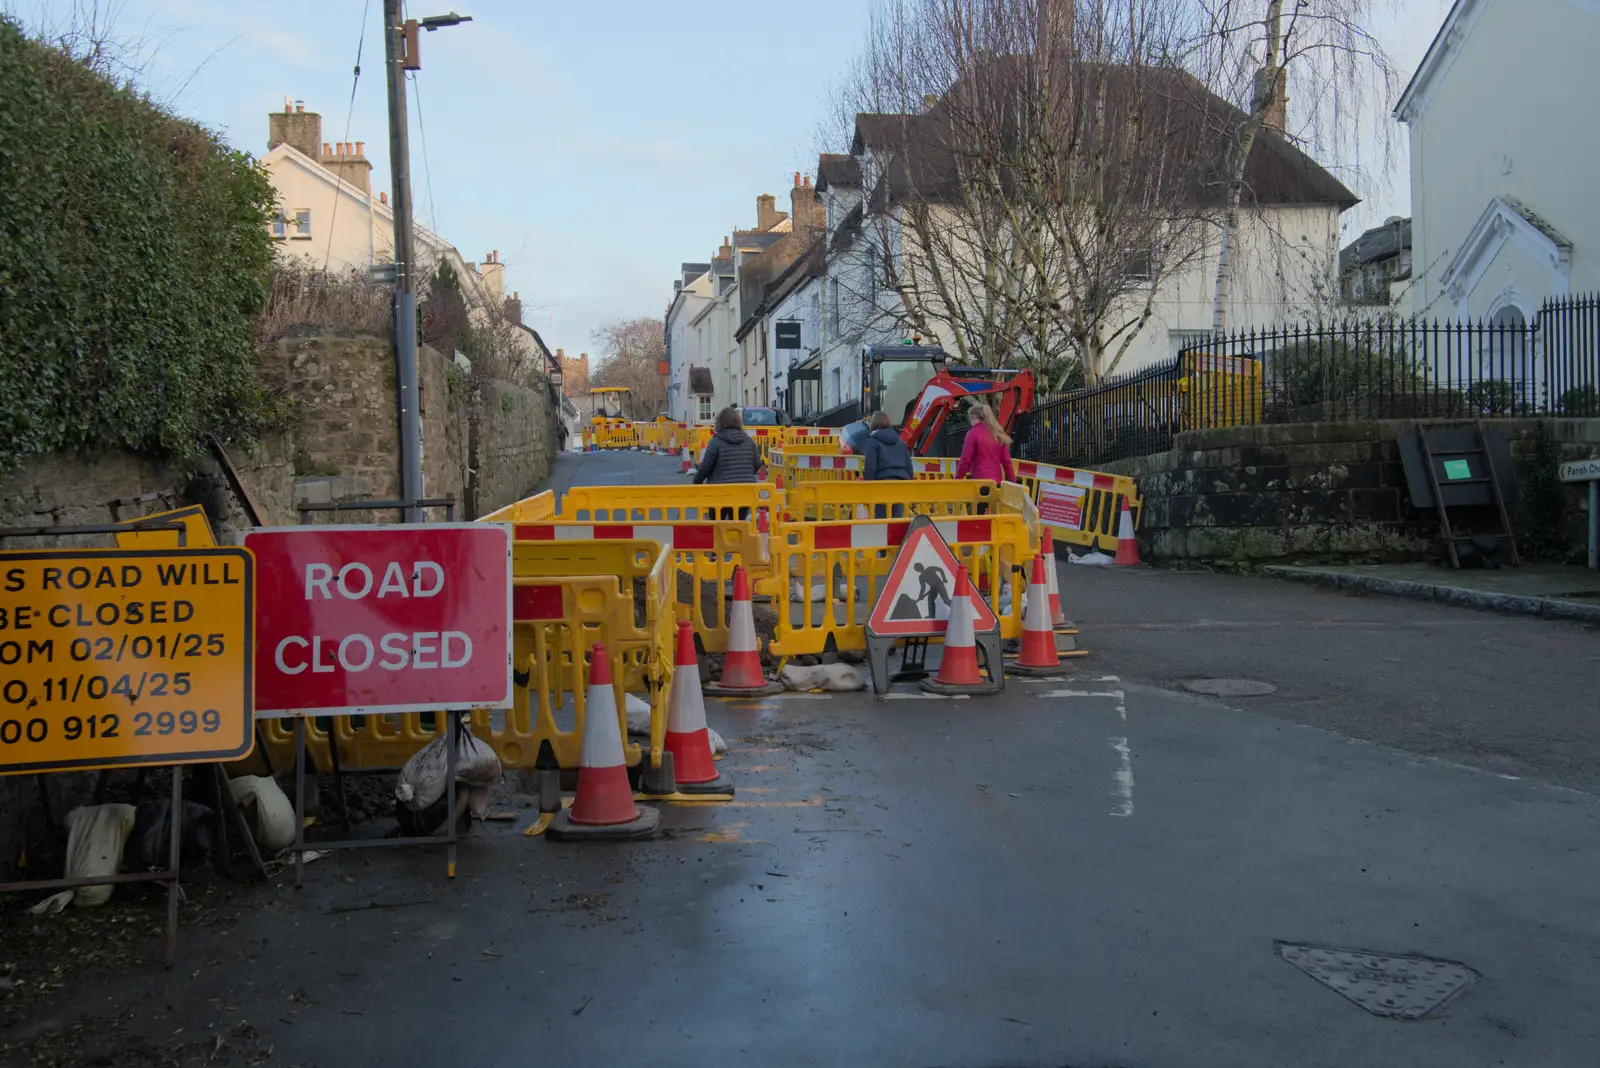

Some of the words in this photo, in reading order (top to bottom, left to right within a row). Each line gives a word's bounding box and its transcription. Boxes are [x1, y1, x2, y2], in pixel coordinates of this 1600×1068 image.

[1567, 463, 1588, 477] Parish
[1589, 463, 1600, 475] Ch
[42, 565, 142, 590] ROAD
[157, 562, 239, 586] WILL
[305, 561, 445, 600] ROAD
[48, 600, 194, 628] CLOSED
[70, 632, 225, 662] 02/01/25
[274, 630, 473, 675] CLOSED
[42, 672, 192, 703] 11/04/25
[63, 714, 120, 741] 912
[133, 709, 221, 737] 2999
